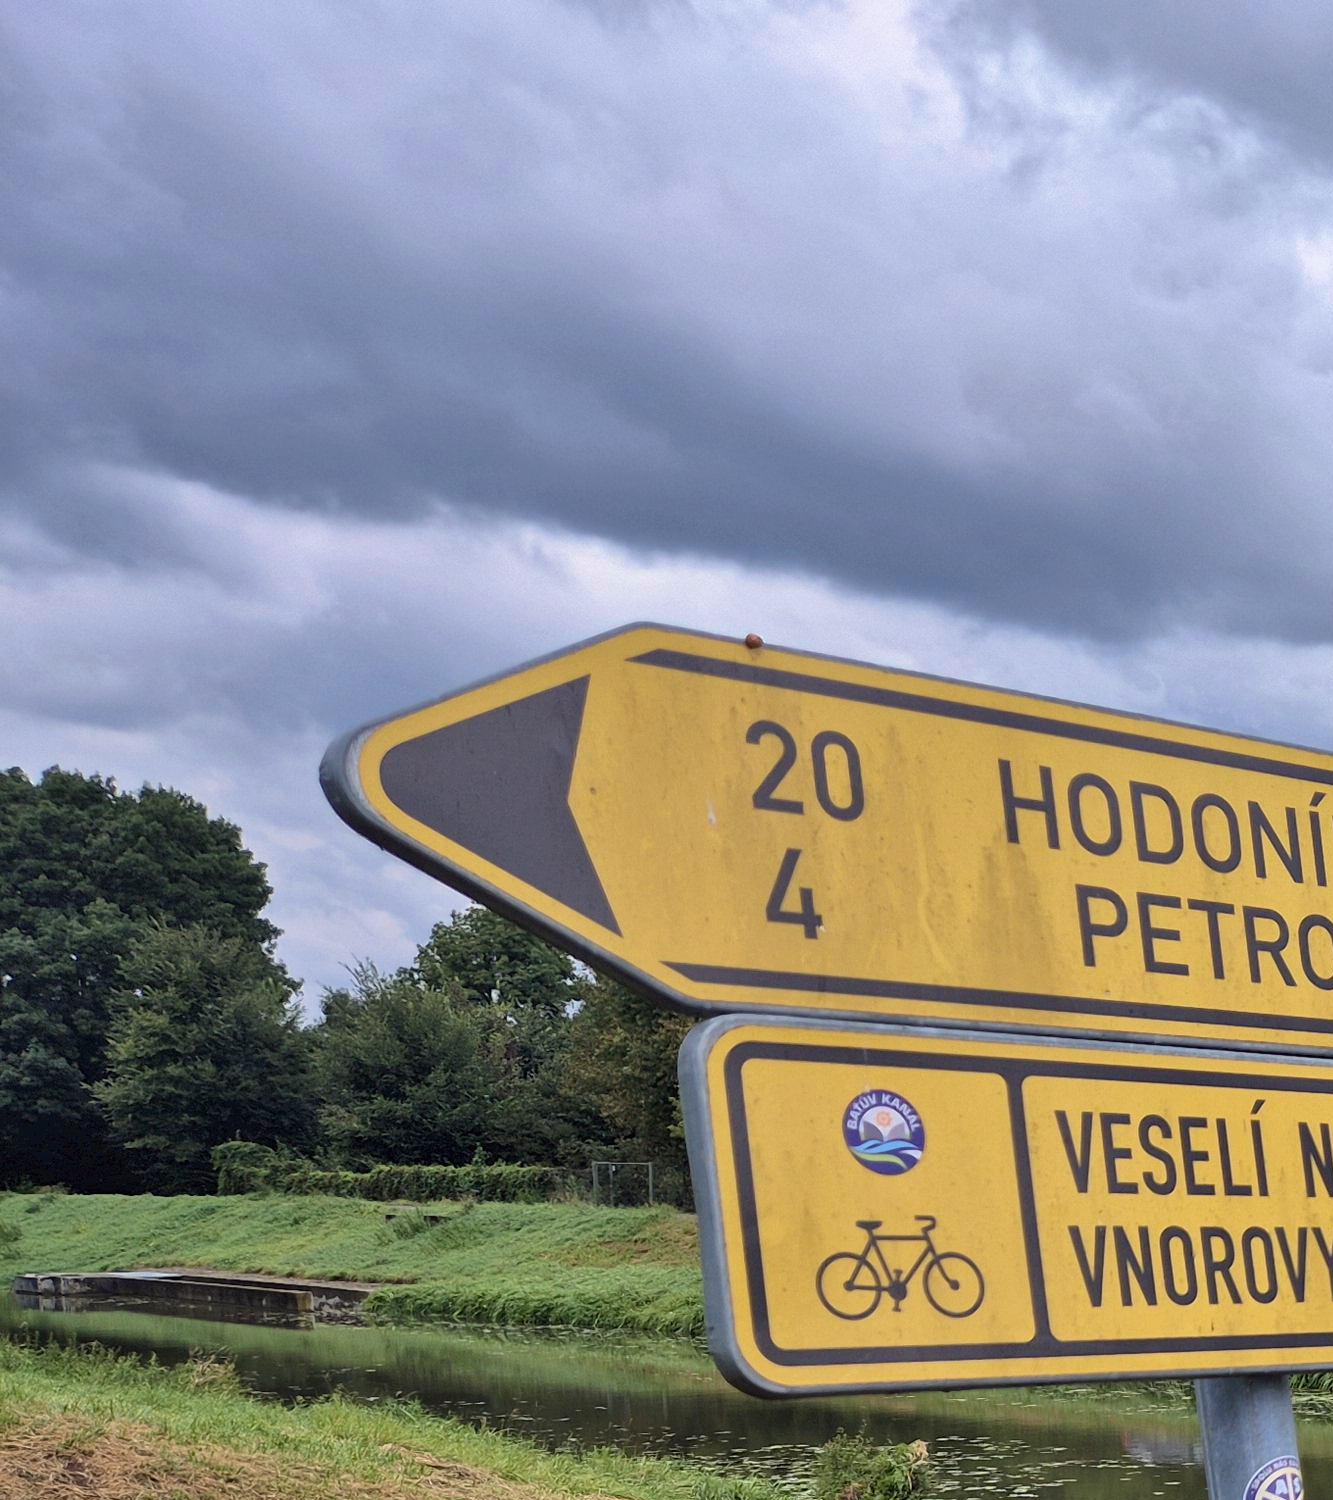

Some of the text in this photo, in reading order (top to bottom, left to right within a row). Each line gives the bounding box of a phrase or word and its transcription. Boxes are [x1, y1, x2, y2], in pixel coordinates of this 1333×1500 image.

[745, 720, 865, 822] 20
[766, 849, 823, 939] 4
[1055, 1100, 1269, 1197] VESELÍ
